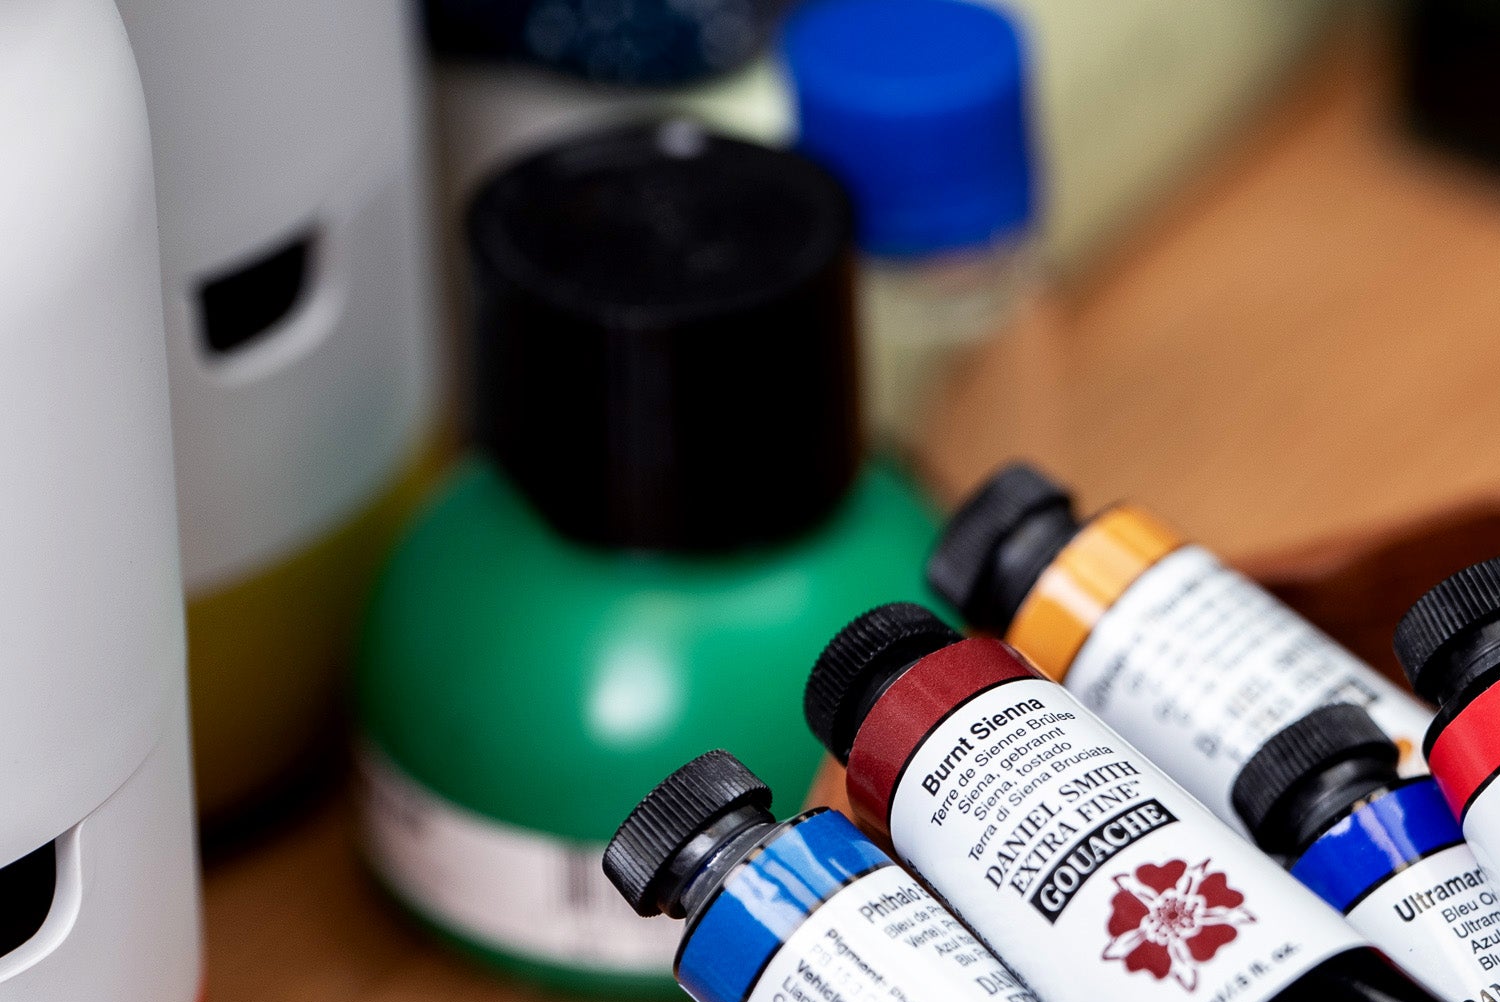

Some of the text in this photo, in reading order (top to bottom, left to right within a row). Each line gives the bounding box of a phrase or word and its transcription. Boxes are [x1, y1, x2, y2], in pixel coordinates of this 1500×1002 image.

[921, 698, 1046, 797] Burnt Sienna
[930, 788, 959, 827] Terre
[958, 767, 976, 787] de
[974, 726, 1028, 768] Sienne
[957, 725, 1066, 815] Siena, gebrannt
[973, 741, 1072, 821] Siena, tostado
[967, 745, 1115, 862] Terra di Siena Bruciata
[984, 760, 1141, 890] DANIEL SMITH
[1009, 820, 1080, 897] EXTRA
[1039, 803, 1169, 912] GOUACHE
[1393, 867, 1487, 923] Ultramar
[858, 883, 921, 924] Phthalo
[1441, 898, 1479, 924] Bleu
[934, 937, 961, 957] Azul
[955, 952, 978, 968] Blu
